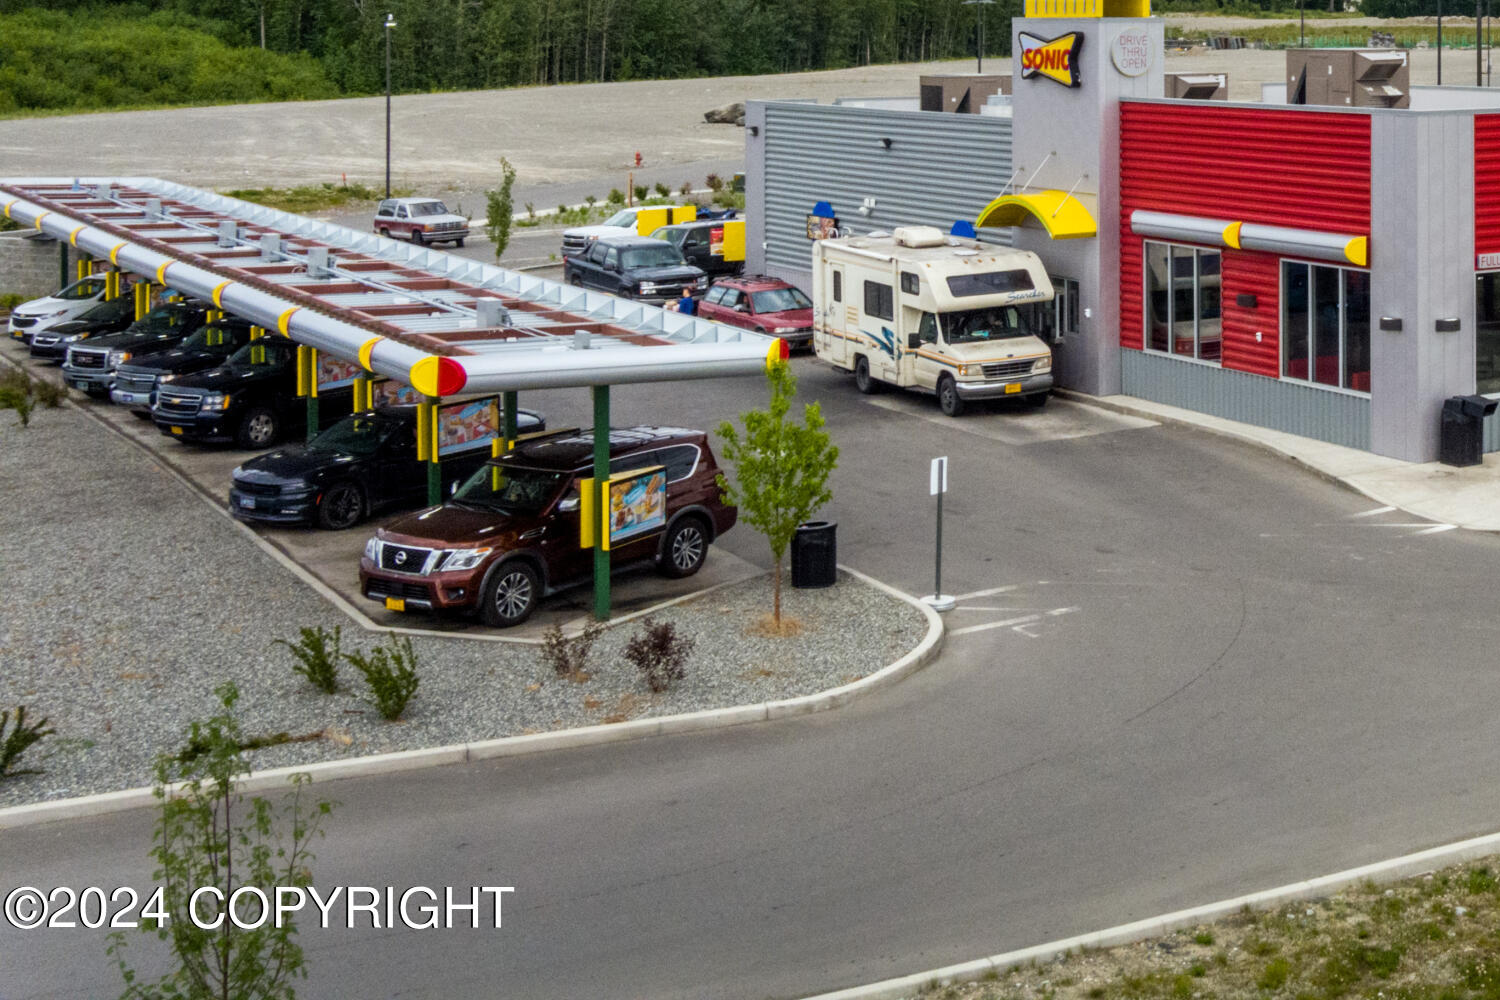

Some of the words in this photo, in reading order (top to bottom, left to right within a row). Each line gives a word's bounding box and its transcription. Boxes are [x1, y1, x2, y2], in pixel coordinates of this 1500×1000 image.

[1119, 35, 1147, 46] DRIVE
[1122, 47, 1147, 57] THRU
[1023, 48, 1071, 71] SONIC
[1121, 59, 1147, 69] OPEN
[1480, 255, 1500, 266] FULL
